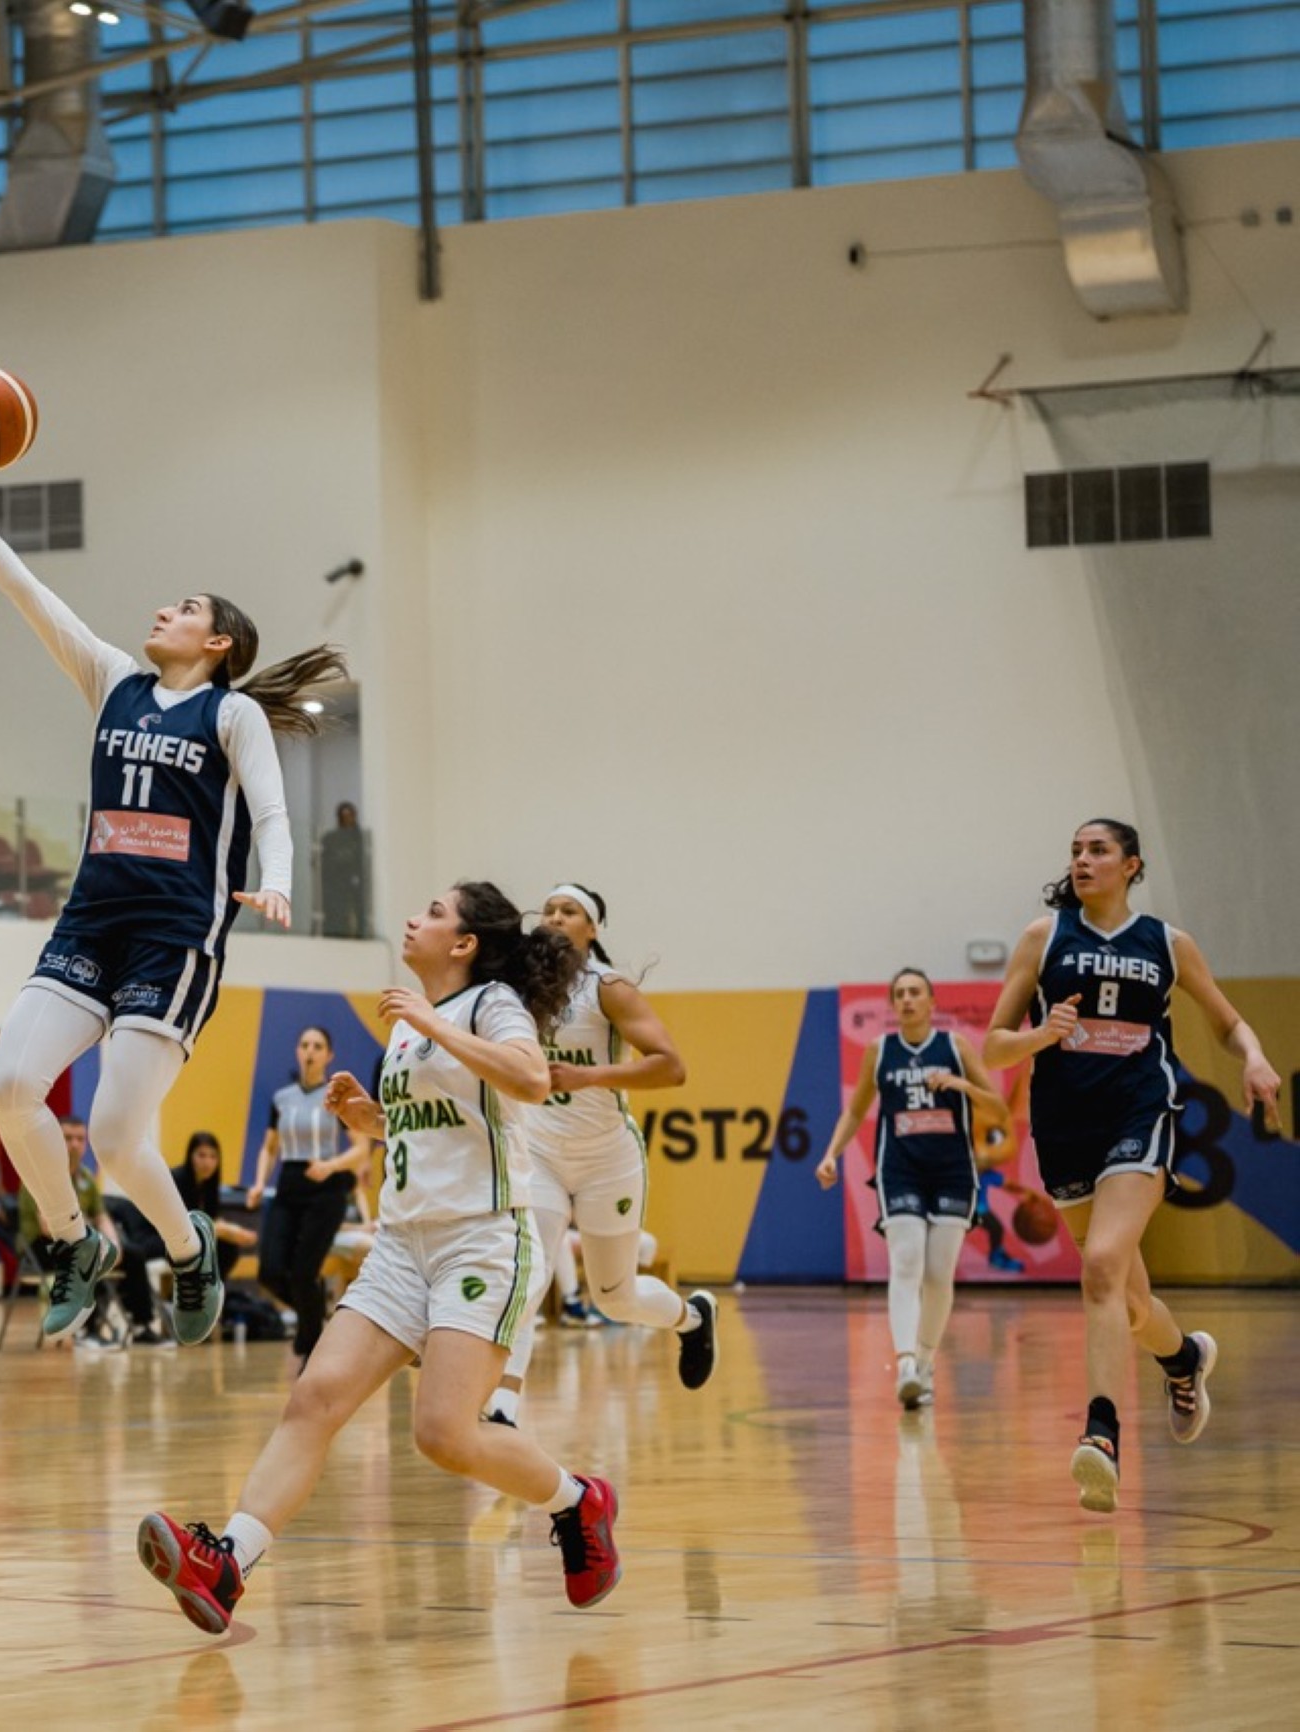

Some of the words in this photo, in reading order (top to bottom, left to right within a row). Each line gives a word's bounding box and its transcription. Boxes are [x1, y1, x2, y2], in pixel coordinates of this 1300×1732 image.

[107, 729, 207, 774] FUHEIS
[121, 763, 154, 808] 11
[1077, 952, 1160, 986] FUHEIS
[1097, 981, 1119, 1016] 8
[382, 1068, 412, 1105] GAZ
[905, 1086, 935, 1111] 34
[392, 1140, 408, 1192] 9
